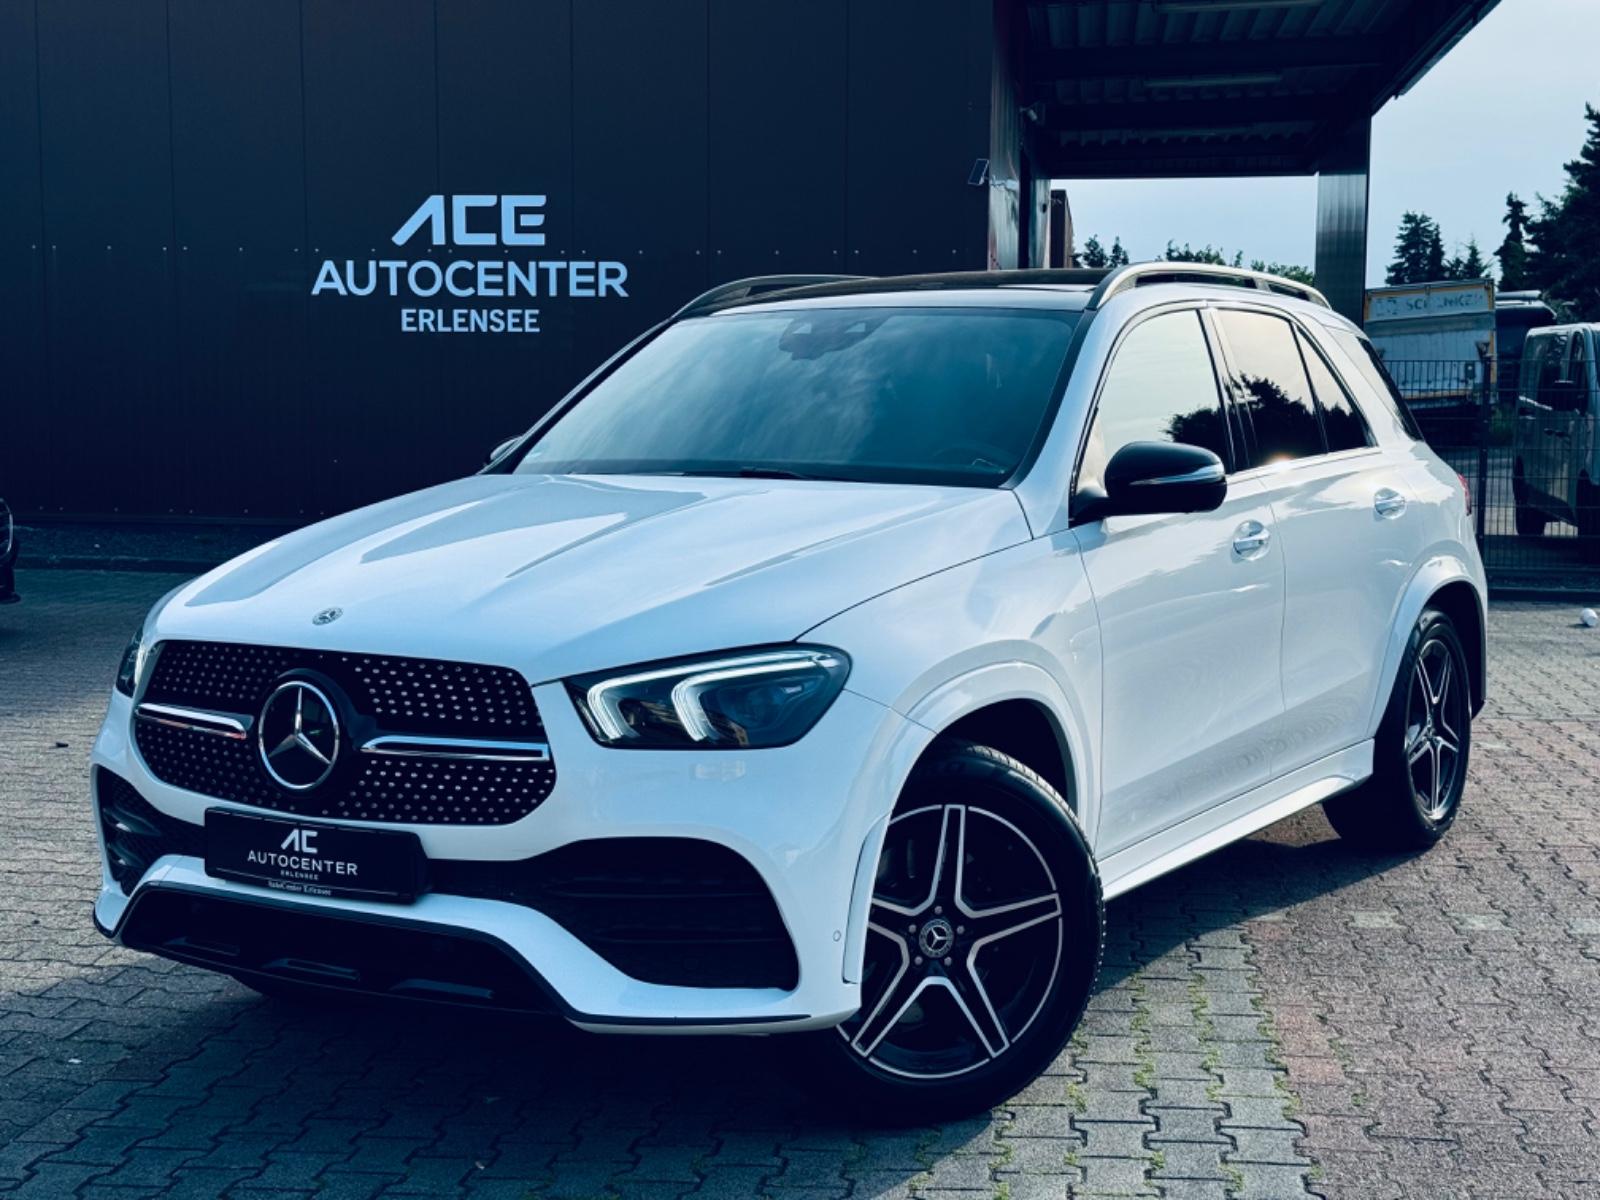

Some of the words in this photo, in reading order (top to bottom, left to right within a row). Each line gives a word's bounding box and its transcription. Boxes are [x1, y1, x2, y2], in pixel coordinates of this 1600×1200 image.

[392, 194, 547, 247] ACE
[311, 259, 629, 298] AUTOCENTER
[401, 308, 541, 334] ERLENSEE
[280, 828, 318, 854] AC
[247, 850, 358, 876] AUTOCENTER
[280, 870, 318, 881] ERLENSEE
